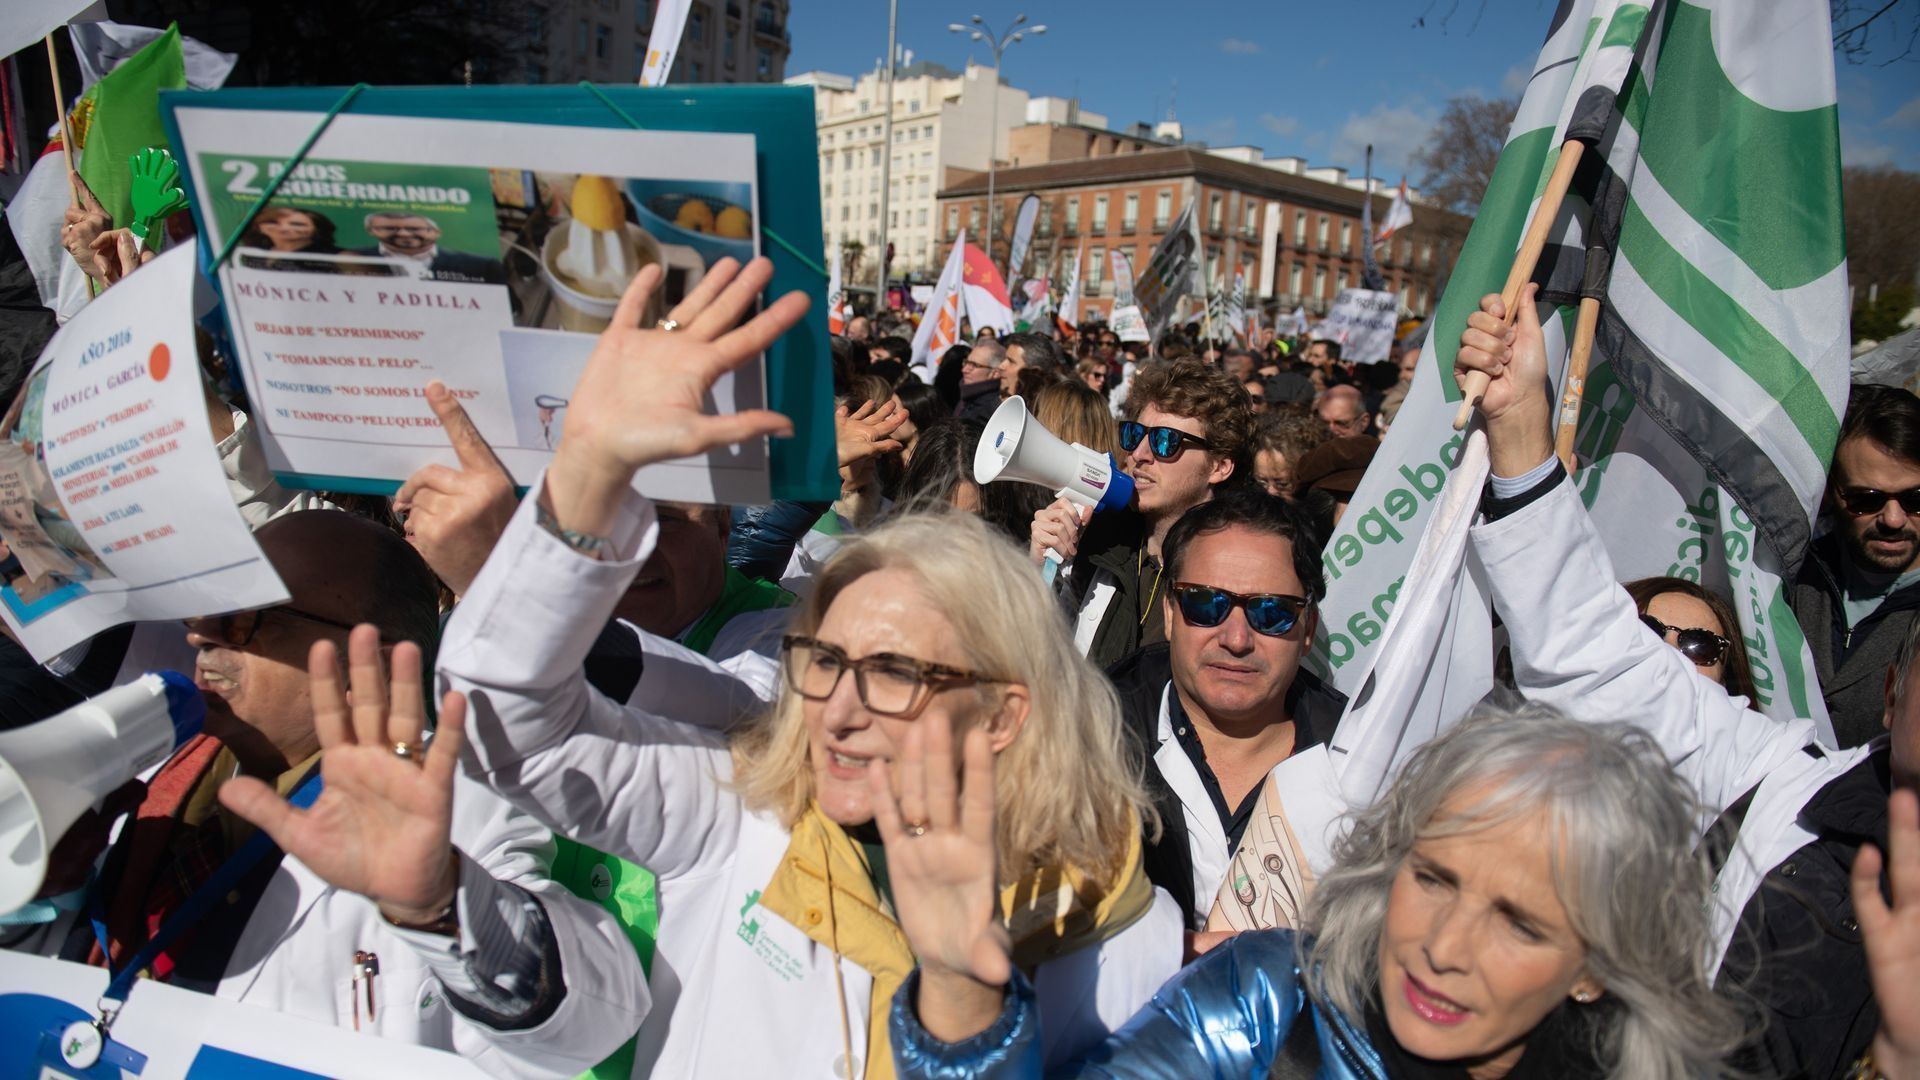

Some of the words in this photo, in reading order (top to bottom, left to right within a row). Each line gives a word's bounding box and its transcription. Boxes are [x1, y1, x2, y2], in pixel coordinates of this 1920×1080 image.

[221, 159, 265, 194] 2
[274, 180, 471, 205] GOBERNANDO
[236, 282, 329, 303] MÓNICA
[344, 290, 356, 303] Y
[377, 291, 482, 311] PADILLA
[255, 322, 294, 336] DEJAR
[297, 324, 315, 337] DE
[79, 342, 104, 367] AÑO
[106, 327, 132, 352] 2016
[264, 352, 273, 363] Y
[358, 356, 375, 368] EL
[52, 386, 100, 416] MÓNICA
[106, 362, 147, 390] GARCÍA
[266, 379, 332, 396] NOSOTROS
[363, 386, 410, 398] SOMOS
[276, 407, 290, 419] NI
[292, 410, 353, 425] TAMPOCO
[51, 455, 95, 479] SOLAMENTE
[94, 447, 116, 464] HACE
[116, 437, 141, 454] FALTA
